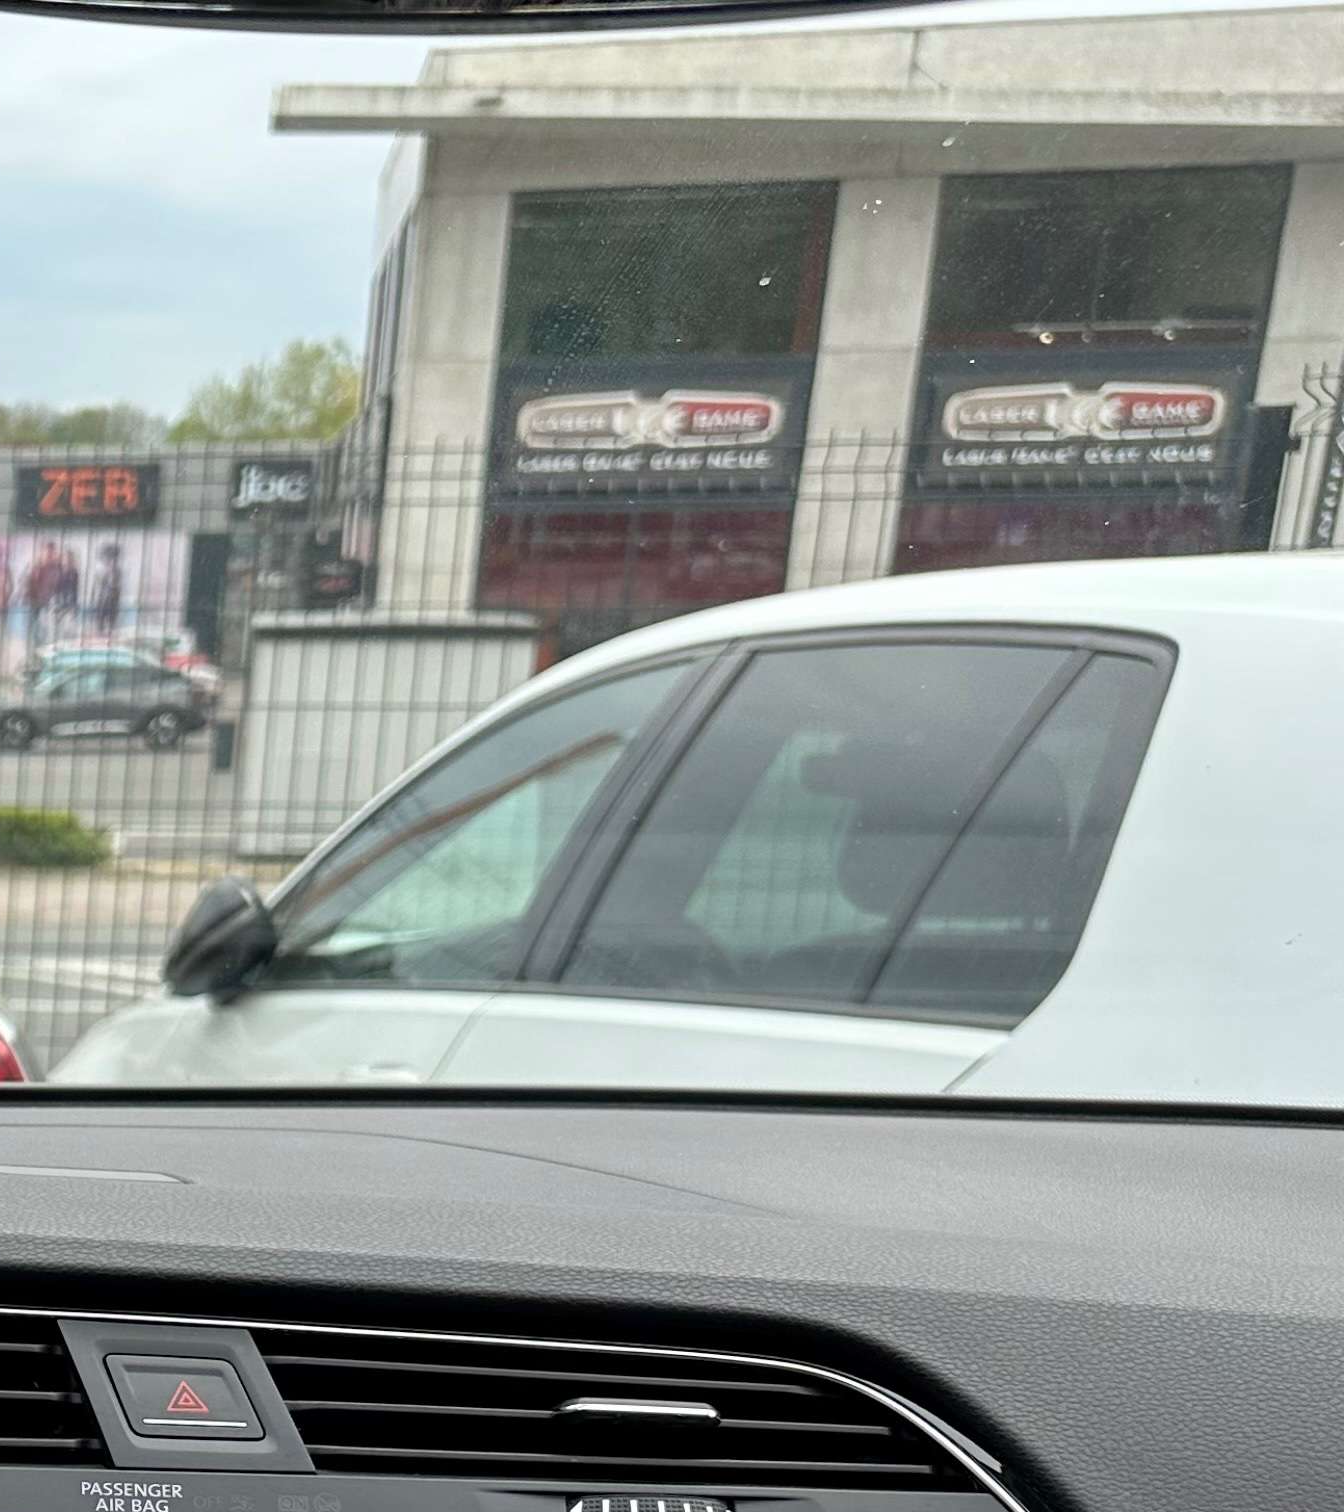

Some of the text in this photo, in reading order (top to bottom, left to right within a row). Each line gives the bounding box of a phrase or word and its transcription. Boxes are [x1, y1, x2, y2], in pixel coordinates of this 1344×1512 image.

[81, 1481, 183, 1498] PASSENGER
[96, 1498, 168, 1512] AIR BAG
